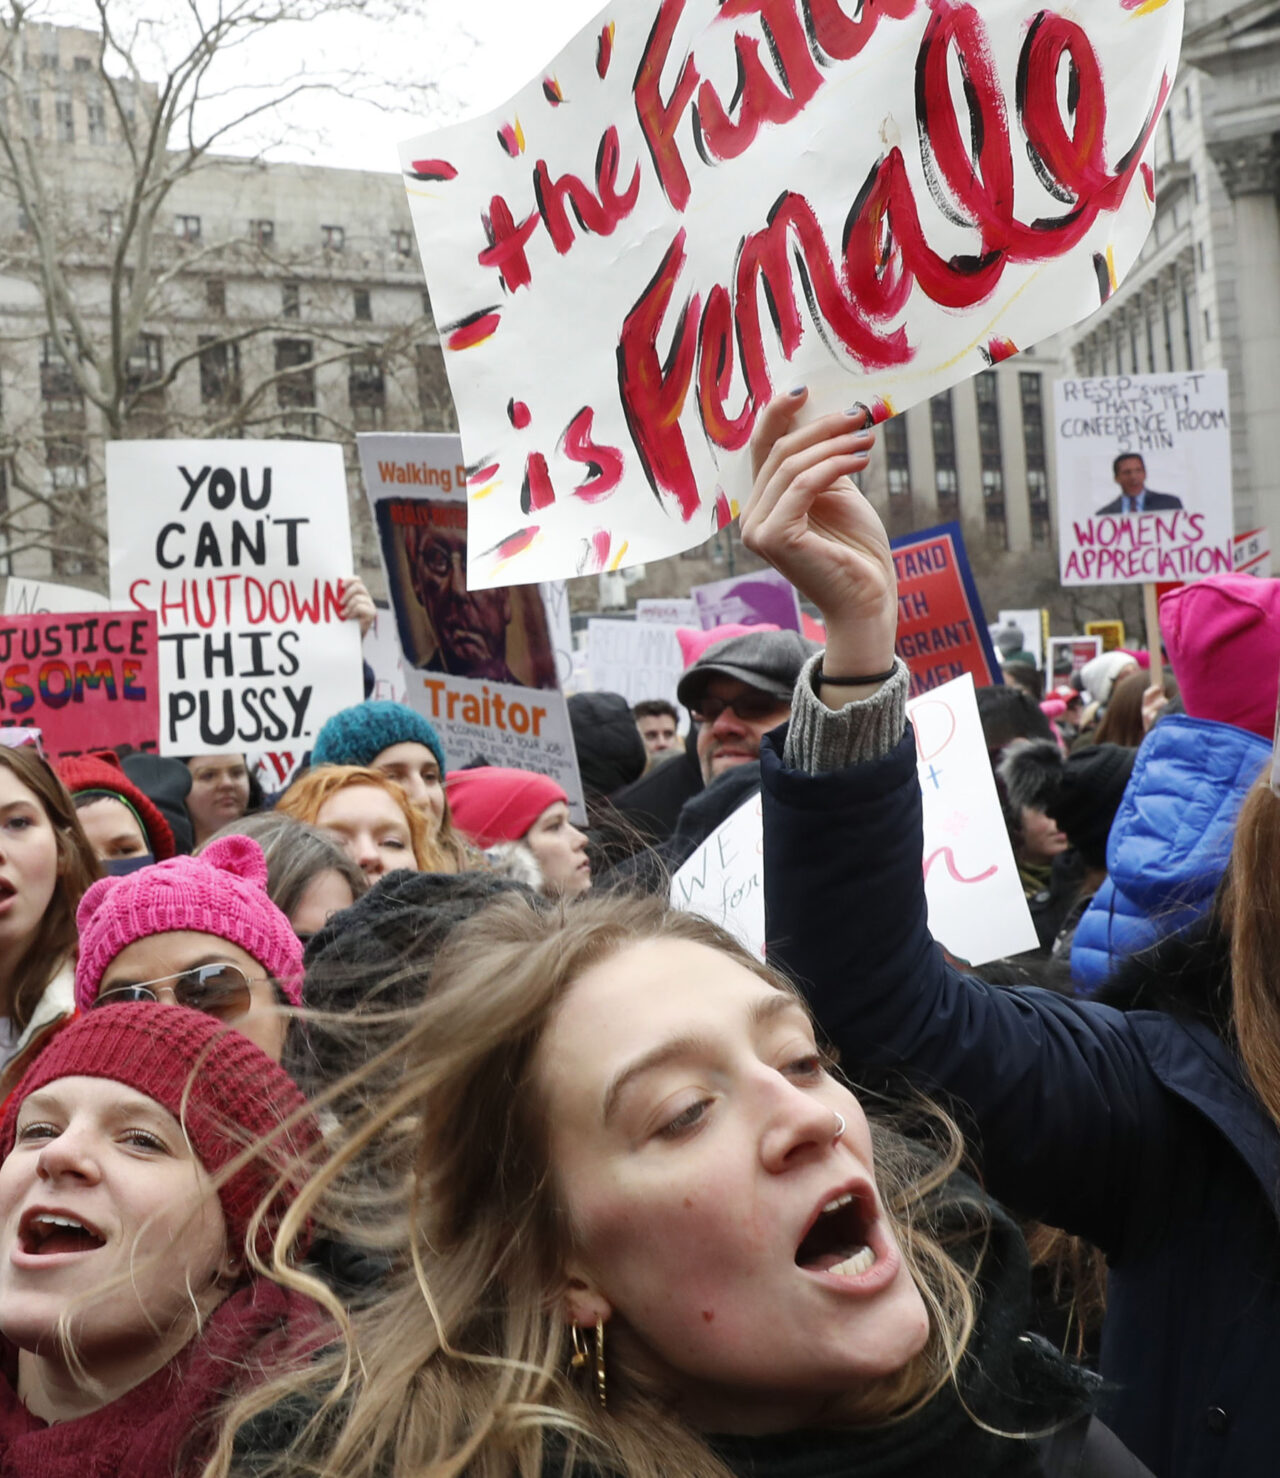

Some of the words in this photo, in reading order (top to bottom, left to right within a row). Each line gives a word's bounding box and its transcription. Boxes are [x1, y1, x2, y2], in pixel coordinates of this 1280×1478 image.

[477, 126, 640, 294] the
[520, 396, 624, 515] is
[617, 0, 1170, 523] Female
[1139, 434, 1173, 450] MIN
[1176, 408, 1228, 432] ROOM
[178, 466, 271, 511] YOU
[377, 460, 451, 493] Walking
[156, 514, 310, 569] CAN'T
[1073, 510, 1205, 548] WOMEN'S
[895, 545, 947, 579] TAND
[1065, 539, 1234, 580] APPRECIATION
[129, 574, 348, 628] SHUTDOWN
[897, 591, 929, 623] TH
[158, 631, 300, 680] THIS
[4, 659, 147, 714] SOME
[907, 662, 963, 695] OMEN
[169, 685, 312, 746] PUSSY.
[424, 679, 547, 736] Traitor
